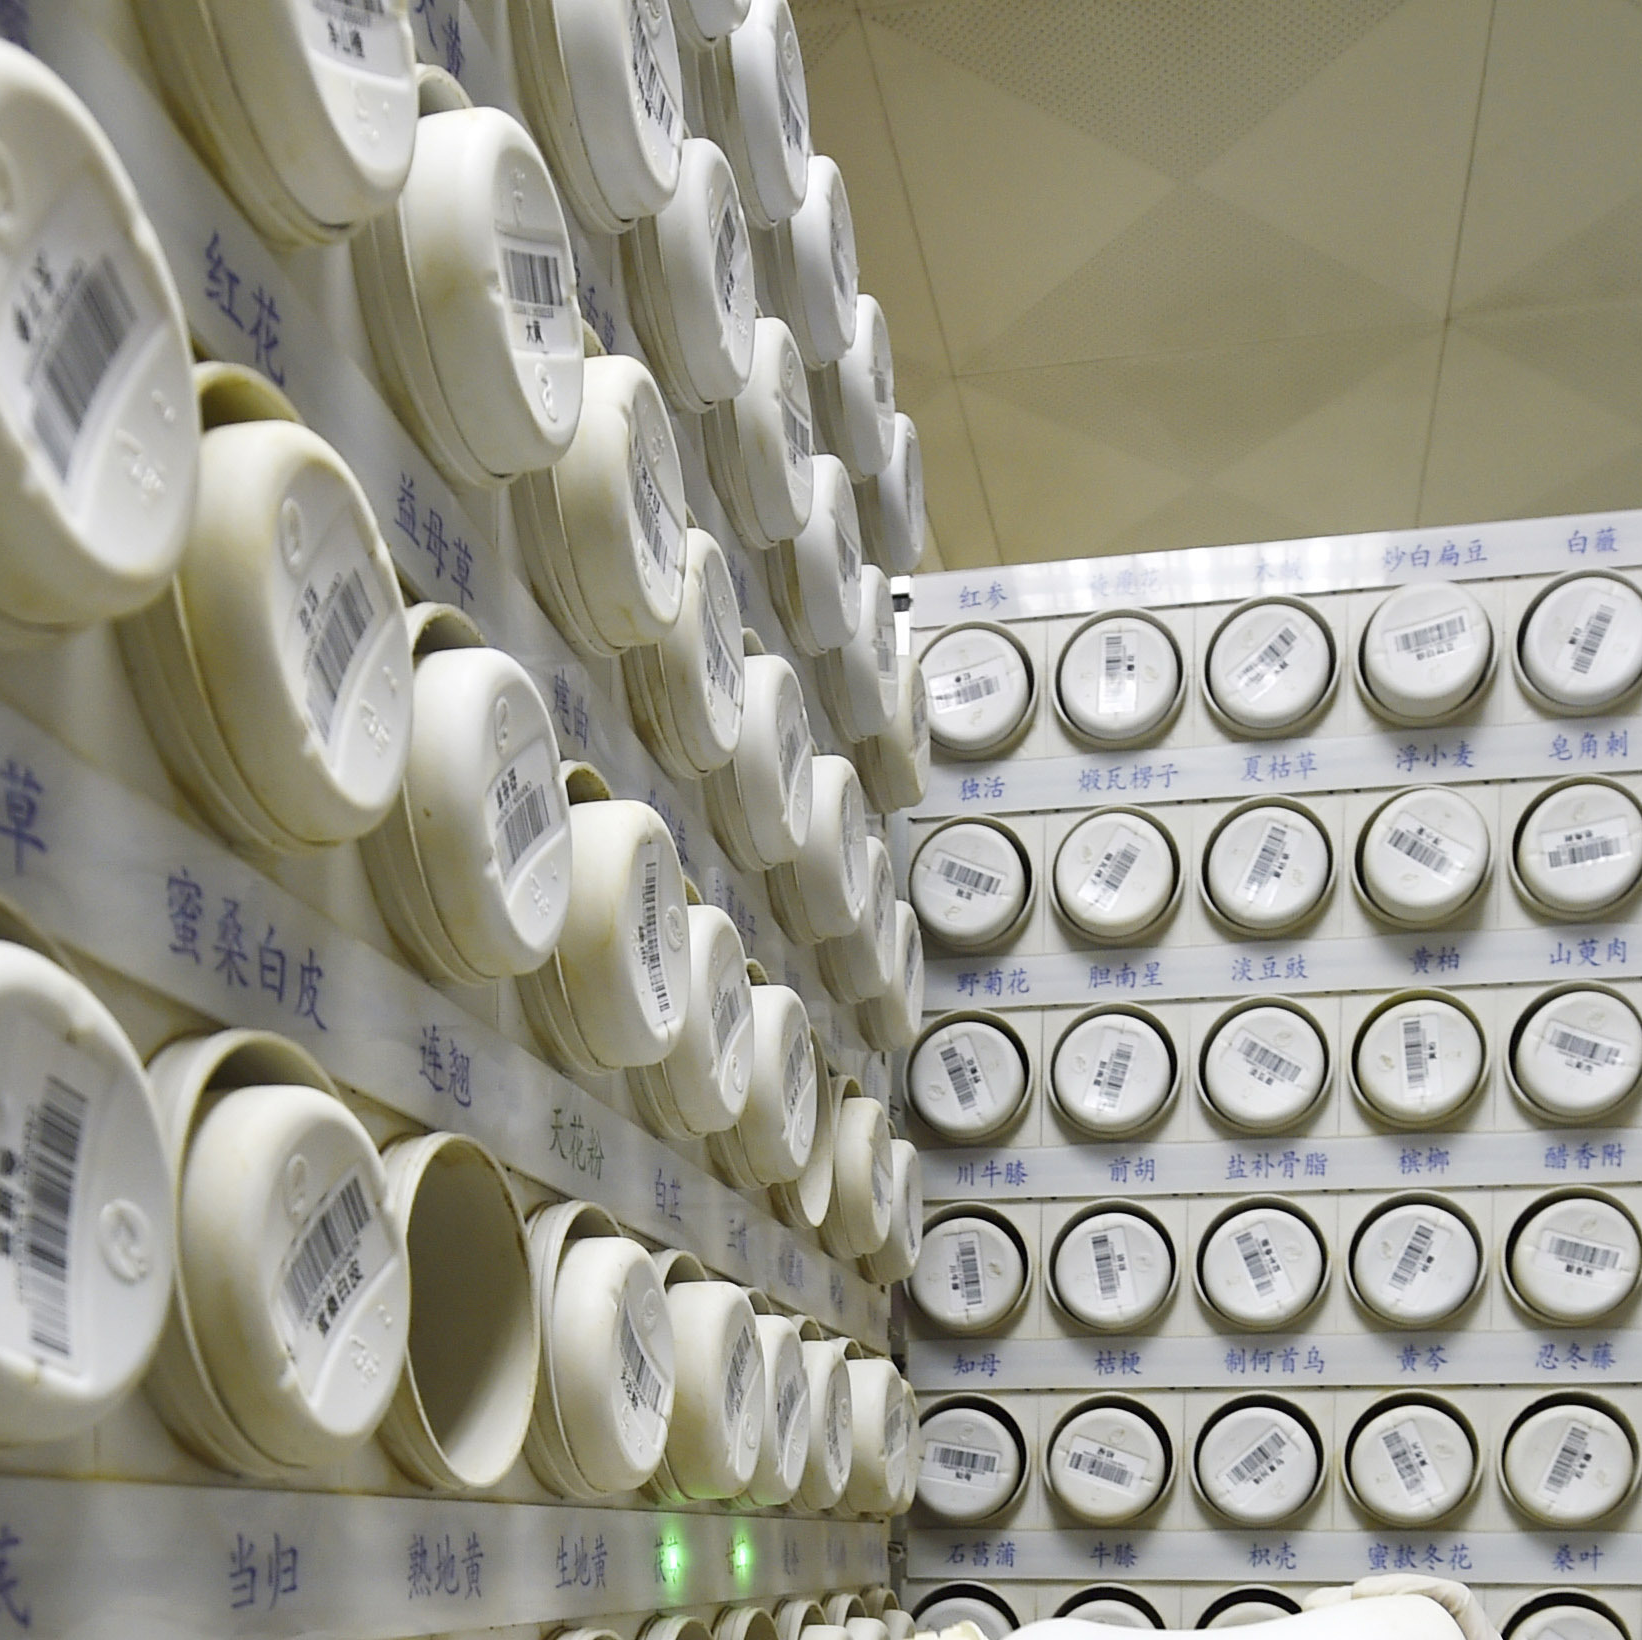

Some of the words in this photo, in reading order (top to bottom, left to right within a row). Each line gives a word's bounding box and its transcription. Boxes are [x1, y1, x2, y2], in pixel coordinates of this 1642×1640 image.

[205, 231, 293, 389] 红花
[394, 472, 477, 614] 益母草
[1383, 539, 1488, 572] 炒白扁豆
[959, 581, 1008, 609] 红参
[1396, 742, 1475, 773] 浮小麦
[1549, 729, 1628, 761] 皂角刺
[1078, 763, 1179, 792] 煅瓦楞子
[1241, 750, 1317, 782] 夏枯草
[961, 776, 1005, 802] 独活
[166, 865, 329, 1034] 蜜桑白皮
[1411, 948, 1460, 974] 黄柏
[1550, 937, 1626, 967] 山萸肉
[957, 968, 1030, 997] 野菊花
[1089, 961, 1163, 989] 胆南星
[1231, 955, 1308, 982] 淡豆豉
[419, 1024, 471, 1109] 连翘
[549, 1106, 605, 1181] 天花粉
[1545, 1143, 1625, 1170] 醋香附
[957, 1160, 1029, 1188] 川牛膝
[1108, 1157, 1155, 1184] 前胡
[1226, 1150, 1328, 1180] 盐补骨脂
[1400, 1148, 1449, 1175] 槟榔
[953, 1353, 1001, 1378] 知母
[1095, 1351, 1141, 1375] 桔梗
[1224, 1345, 1325, 1374] 制何首乌
[1397, 1344, 1448, 1372] 黄芩
[1535, 1343, 1616, 1370] 忍冬藤
[408, 1533, 485, 1599] 熟地黄
[557, 1536, 607, 1588] 生地黄
[947, 1541, 1017, 1568] 石菖蒲
[1091, 1544, 1138, 1569] 牛膝
[1249, 1543, 1297, 1570] 枳壳
[1368, 1542, 1473, 1571] 蜜款冬花
[1552, 1544, 1604, 1572] 桑叶
[228, 1533, 299, 1610] 当归
